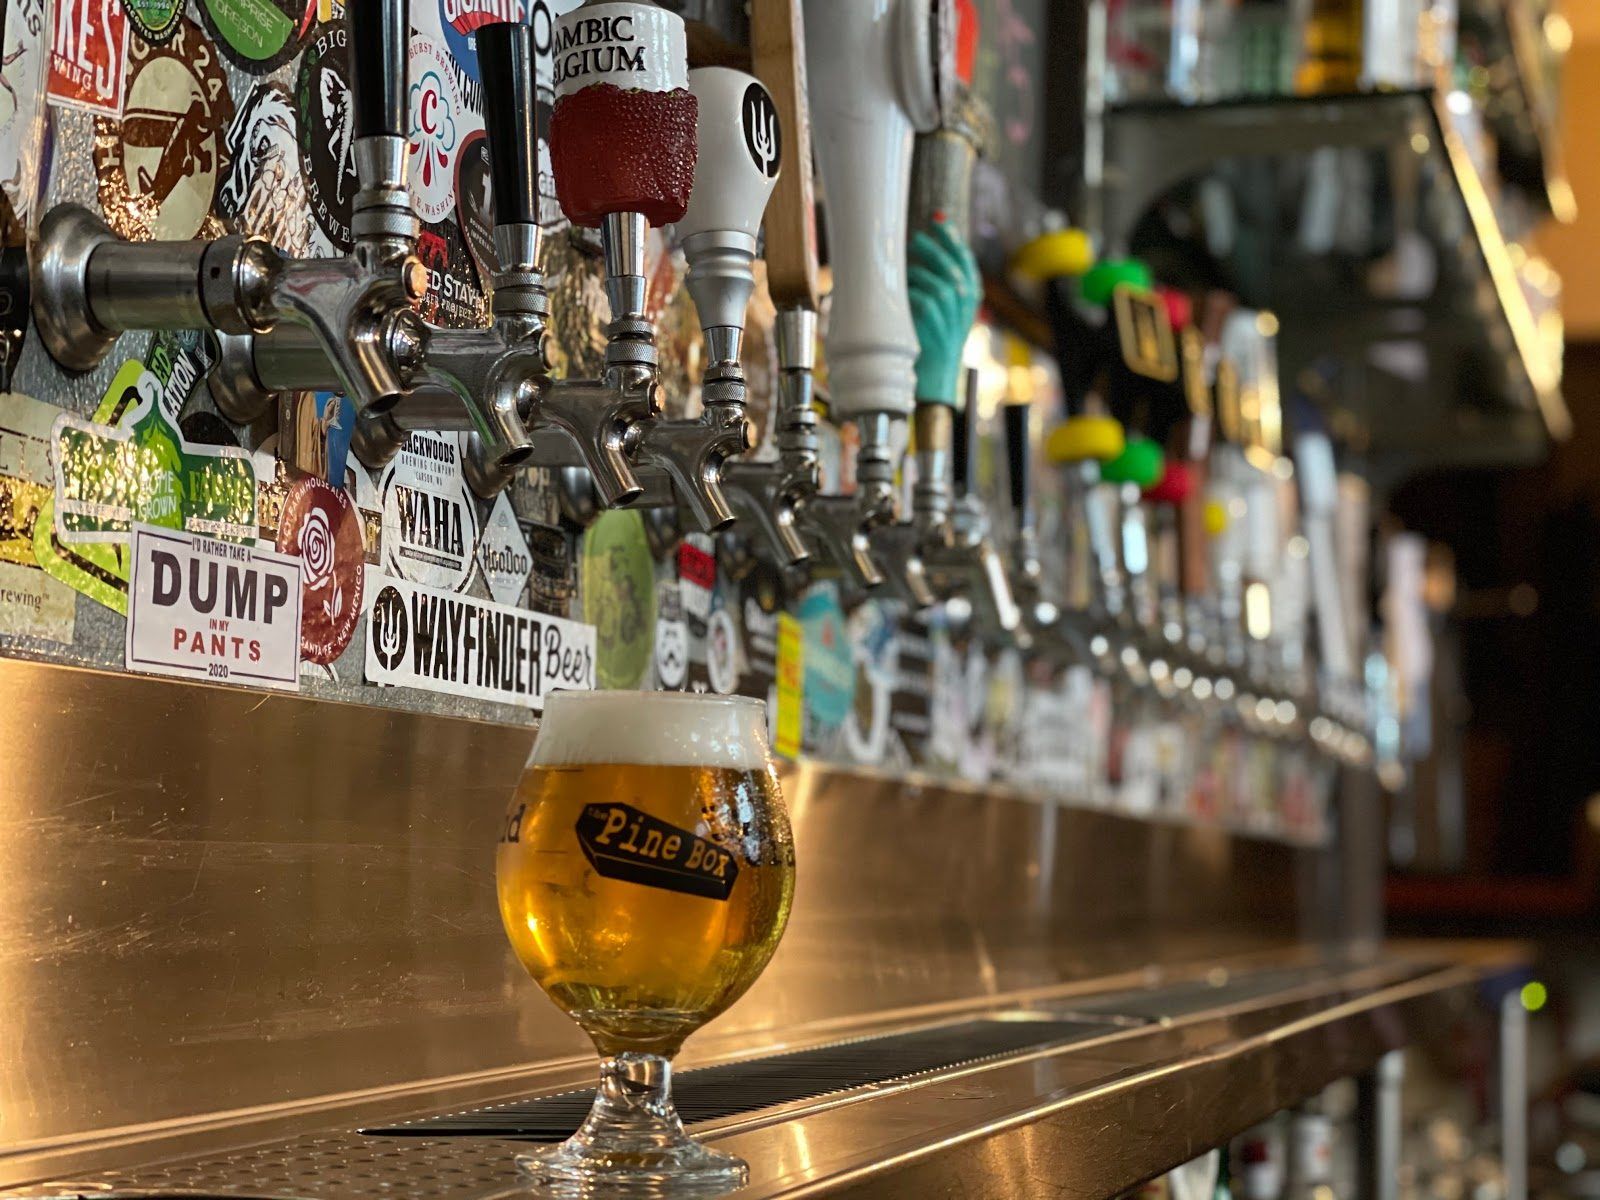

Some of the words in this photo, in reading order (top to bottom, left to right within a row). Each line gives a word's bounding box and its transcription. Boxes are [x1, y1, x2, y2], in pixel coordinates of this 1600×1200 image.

[315, 29, 347, 58] BIG
[408, 42, 432, 60] BURST
[553, 16, 635, 58] AMBIC
[303, 153, 350, 243] BREWE
[424, 190, 454, 216] WASHIN
[164, 347, 197, 419] ATION
[401, 453, 428, 470] BREWING
[430, 461, 455, 477] COMPANY
[138, 495, 177, 520] GROWN
[331, 486, 347, 509] ALES
[395, 484, 465, 557] WAHA
[202, 541, 228, 558] RATHER
[229, 546, 245, 562] TAKE
[247, 550, 252, 562] A
[151, 549, 288, 625] DUMP
[337, 620, 351, 645] NEW
[350, 565, 362, 620] MEXICO
[209, 618, 217, 630] IN
[219, 620, 229, 632] MY
[173, 628, 261, 662] PANTS
[411, 590, 541, 697] WAYFINDER
[544, 624, 593, 691] Beer
[208, 663, 229, 678] 2020
[595, 808, 682, 860] Pine
